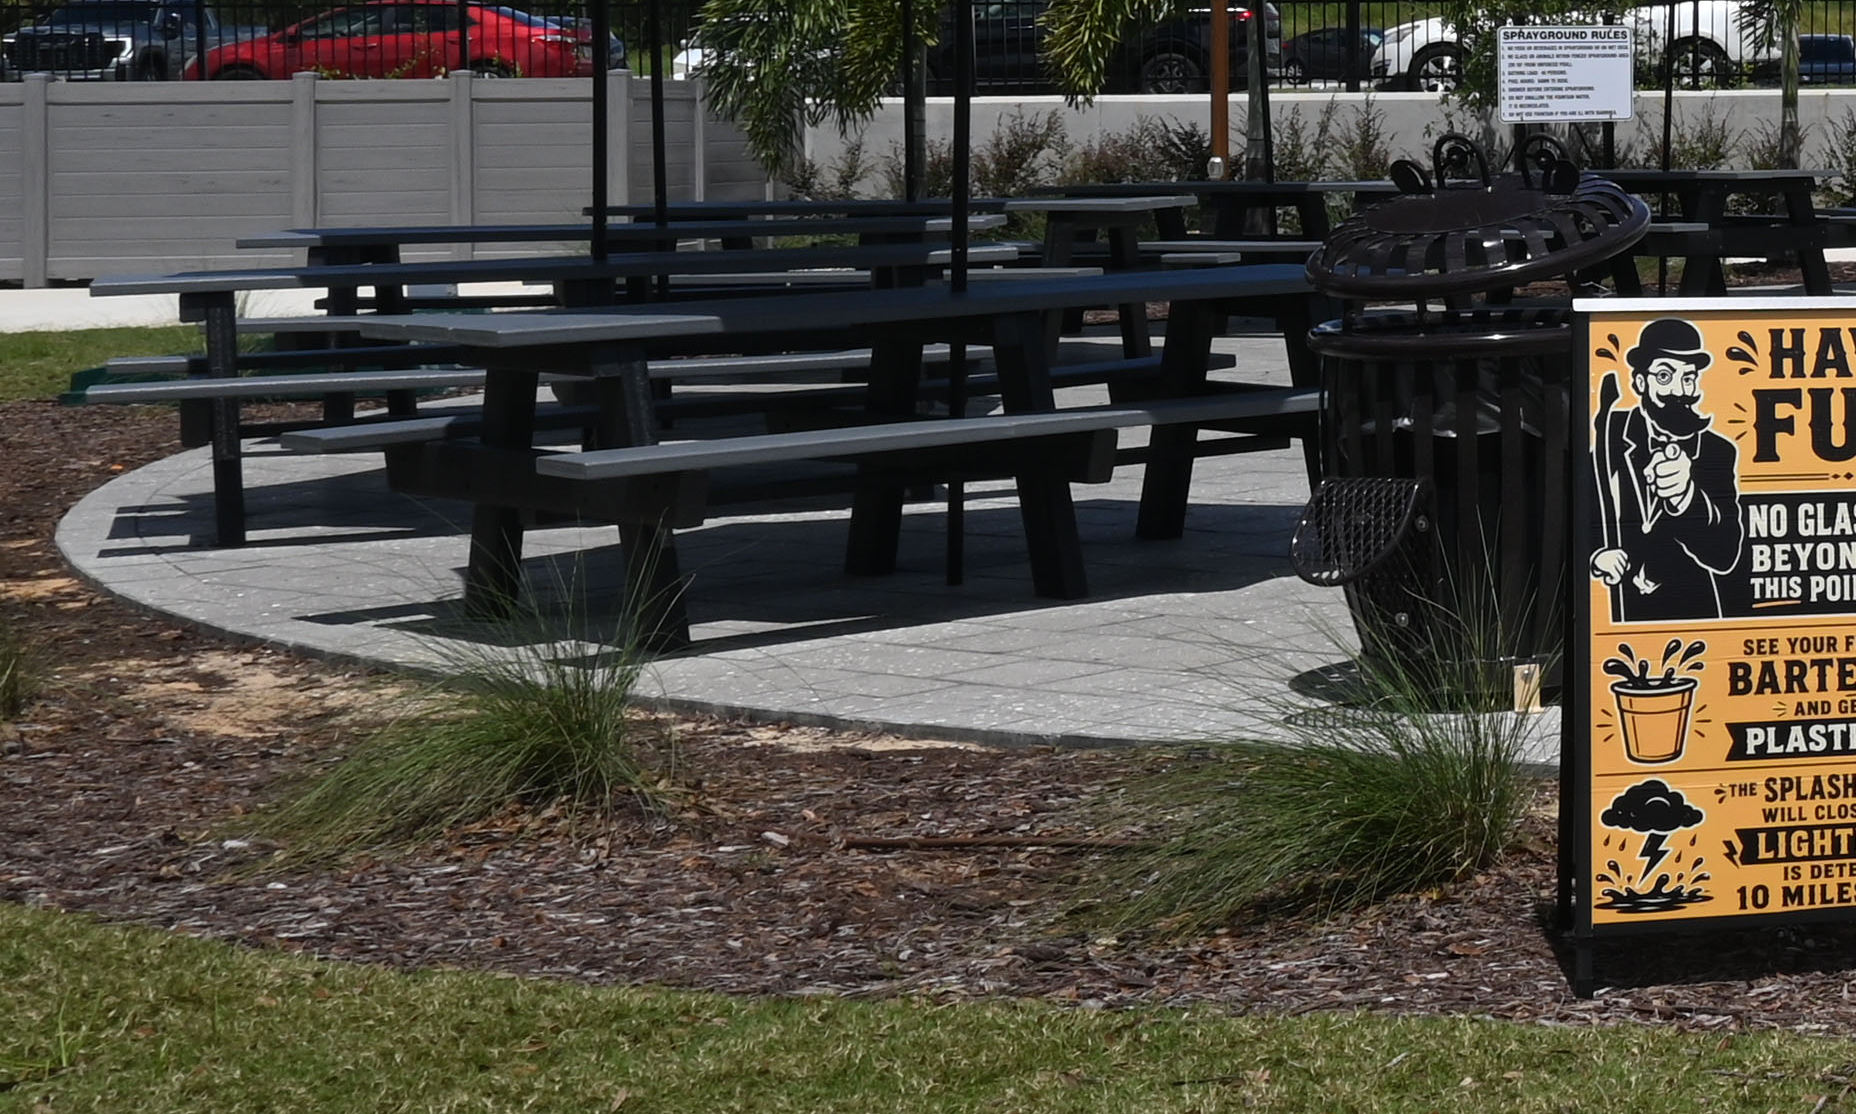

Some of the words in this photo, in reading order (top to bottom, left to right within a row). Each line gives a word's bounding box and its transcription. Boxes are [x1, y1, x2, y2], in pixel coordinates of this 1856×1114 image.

[1503, 30, 1587, 40] SPRAYGROUND
[1591, 31, 1627, 39] RULES
[1748, 503, 1788, 538] NO
[1750, 576, 1802, 599] THIS
[1743, 638, 1780, 656] SEE
[1787, 636, 1838, 654] YOUR
[1794, 700, 1832, 716] AND
[1729, 782, 1757, 798] THE
[1762, 806, 1808, 823] WILL
[1783, 866, 1801, 881] IS
[1736, 884, 1770, 910] 10
